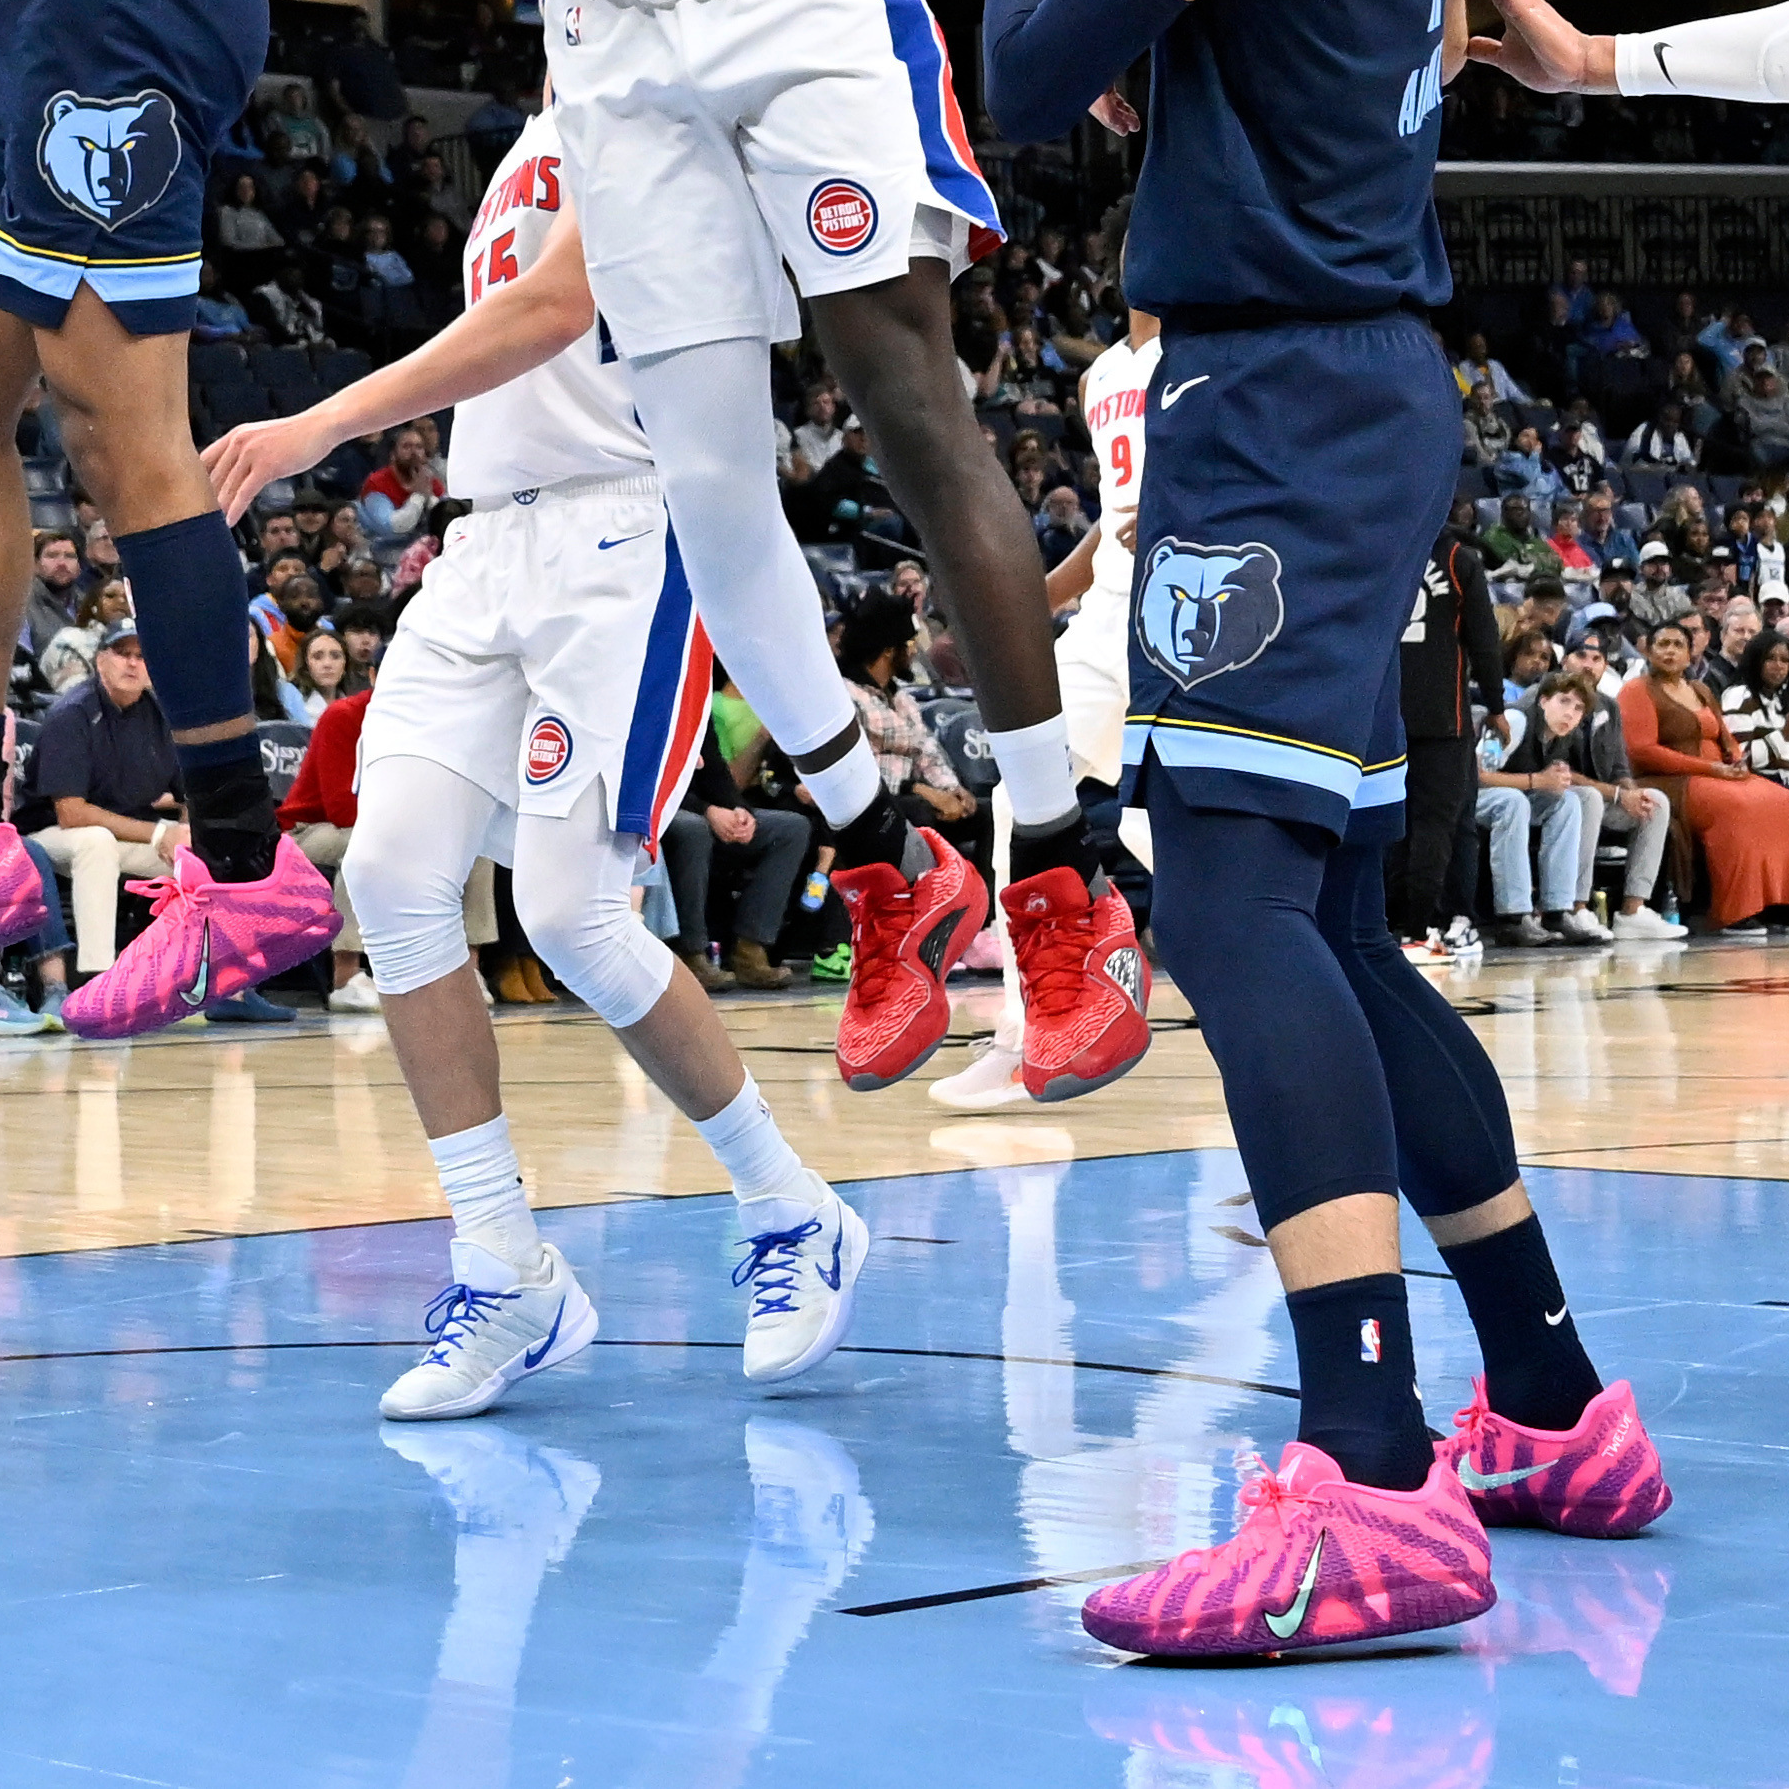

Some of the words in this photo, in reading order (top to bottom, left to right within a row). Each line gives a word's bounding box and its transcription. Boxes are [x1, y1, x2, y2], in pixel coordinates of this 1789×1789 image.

[818, 200, 862, 222] DETROIT
[821, 212, 866, 234] PISTONS
[1086, 387, 1147, 431] PISTON
[1110, 434, 1134, 488] 9
[1601, 1413, 1634, 1459] TWELVE
